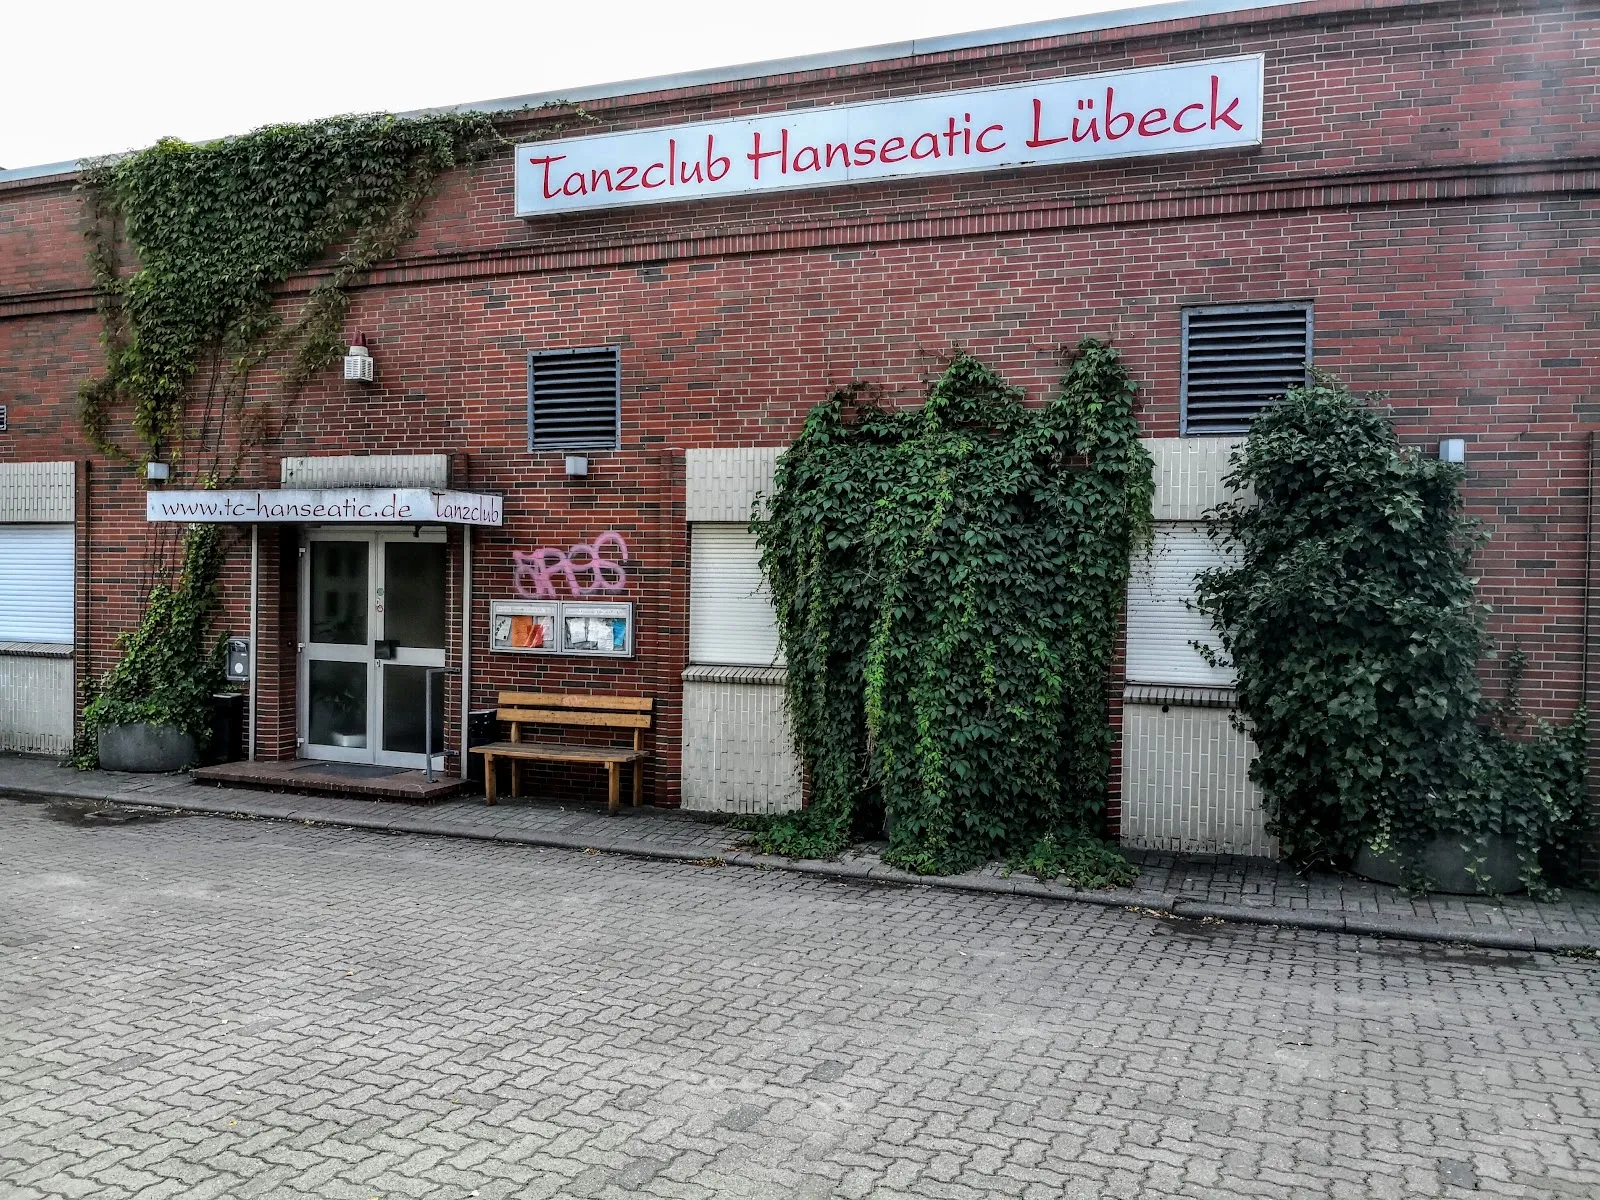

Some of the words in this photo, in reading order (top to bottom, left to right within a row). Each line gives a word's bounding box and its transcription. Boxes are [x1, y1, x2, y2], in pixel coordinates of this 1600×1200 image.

[529, 134, 731, 199] Tanzclub
[747, 112, 1006, 180] Hanseatic
[1025, 75, 1243, 148] Lübeck
[161, 493, 413, 518] www.tc-hanseatic.de
[431, 491, 499, 522] Tanzclub
